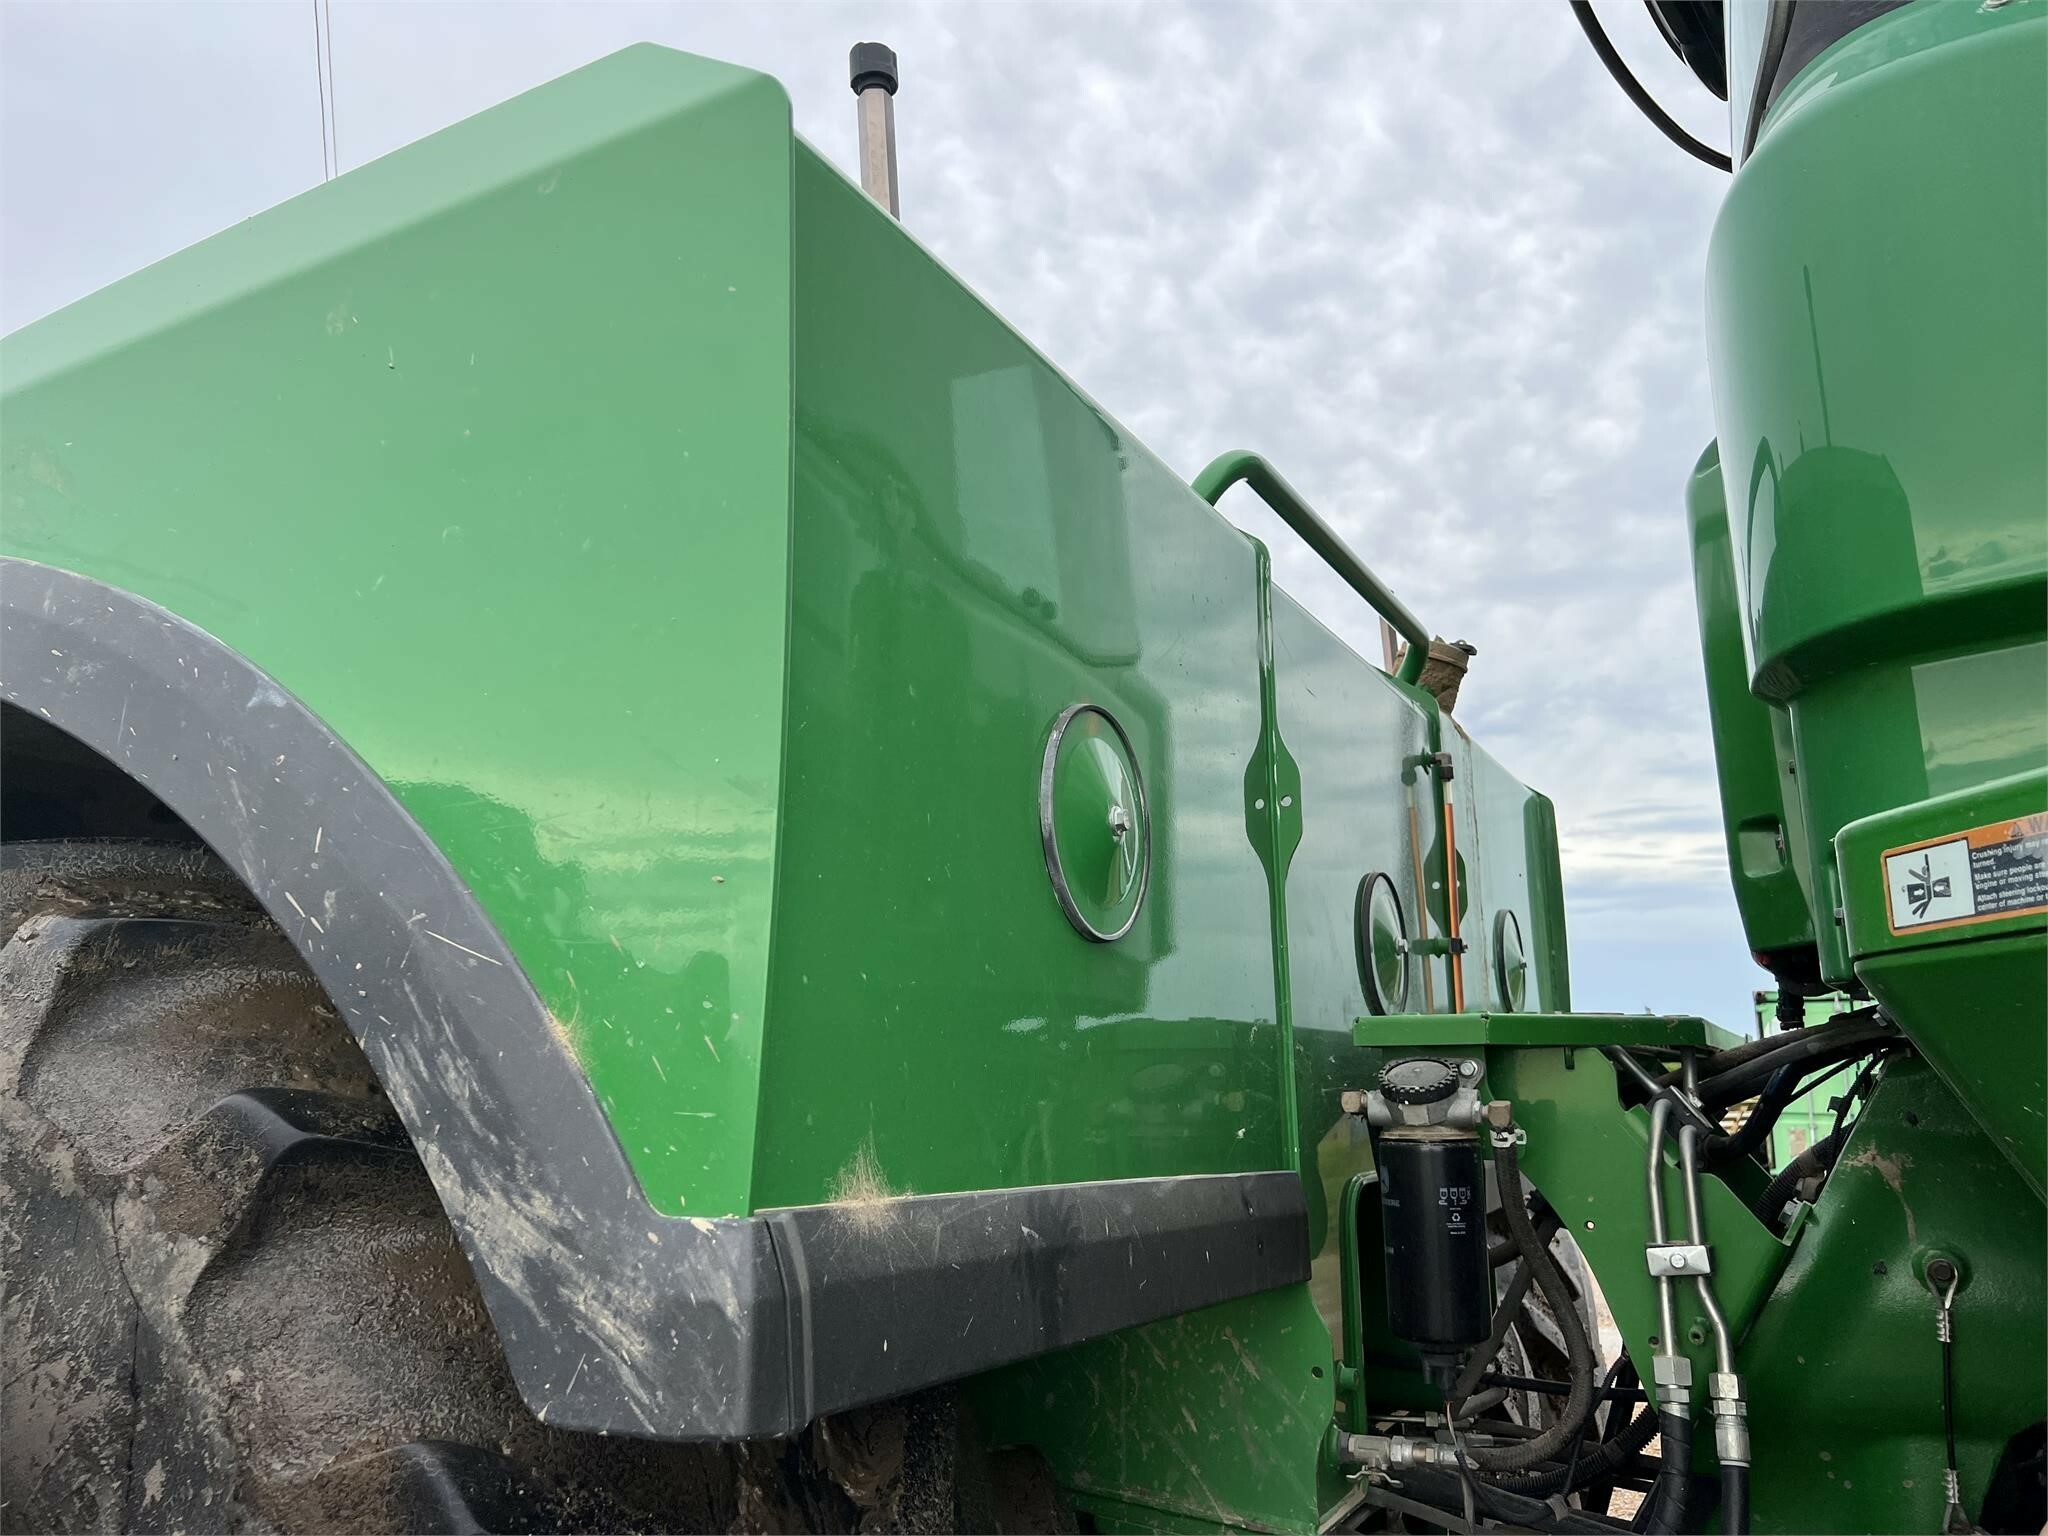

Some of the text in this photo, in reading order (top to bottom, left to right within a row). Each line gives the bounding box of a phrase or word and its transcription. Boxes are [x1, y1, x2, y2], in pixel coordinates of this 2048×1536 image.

[1972, 848, 2002, 859] Crushing
[1974, 872, 1991, 880] Make
[1993, 869, 2008, 877] sure
[2009, 864, 2033, 875] people
[1975, 880, 1997, 890] engine
[2008, 873, 2033, 883] moving
[1977, 893, 1997, 902] Attach
[1999, 888, 2026, 898] steering
[1999, 899, 2006, 907] of
[2007, 896, 2035, 906] machine
